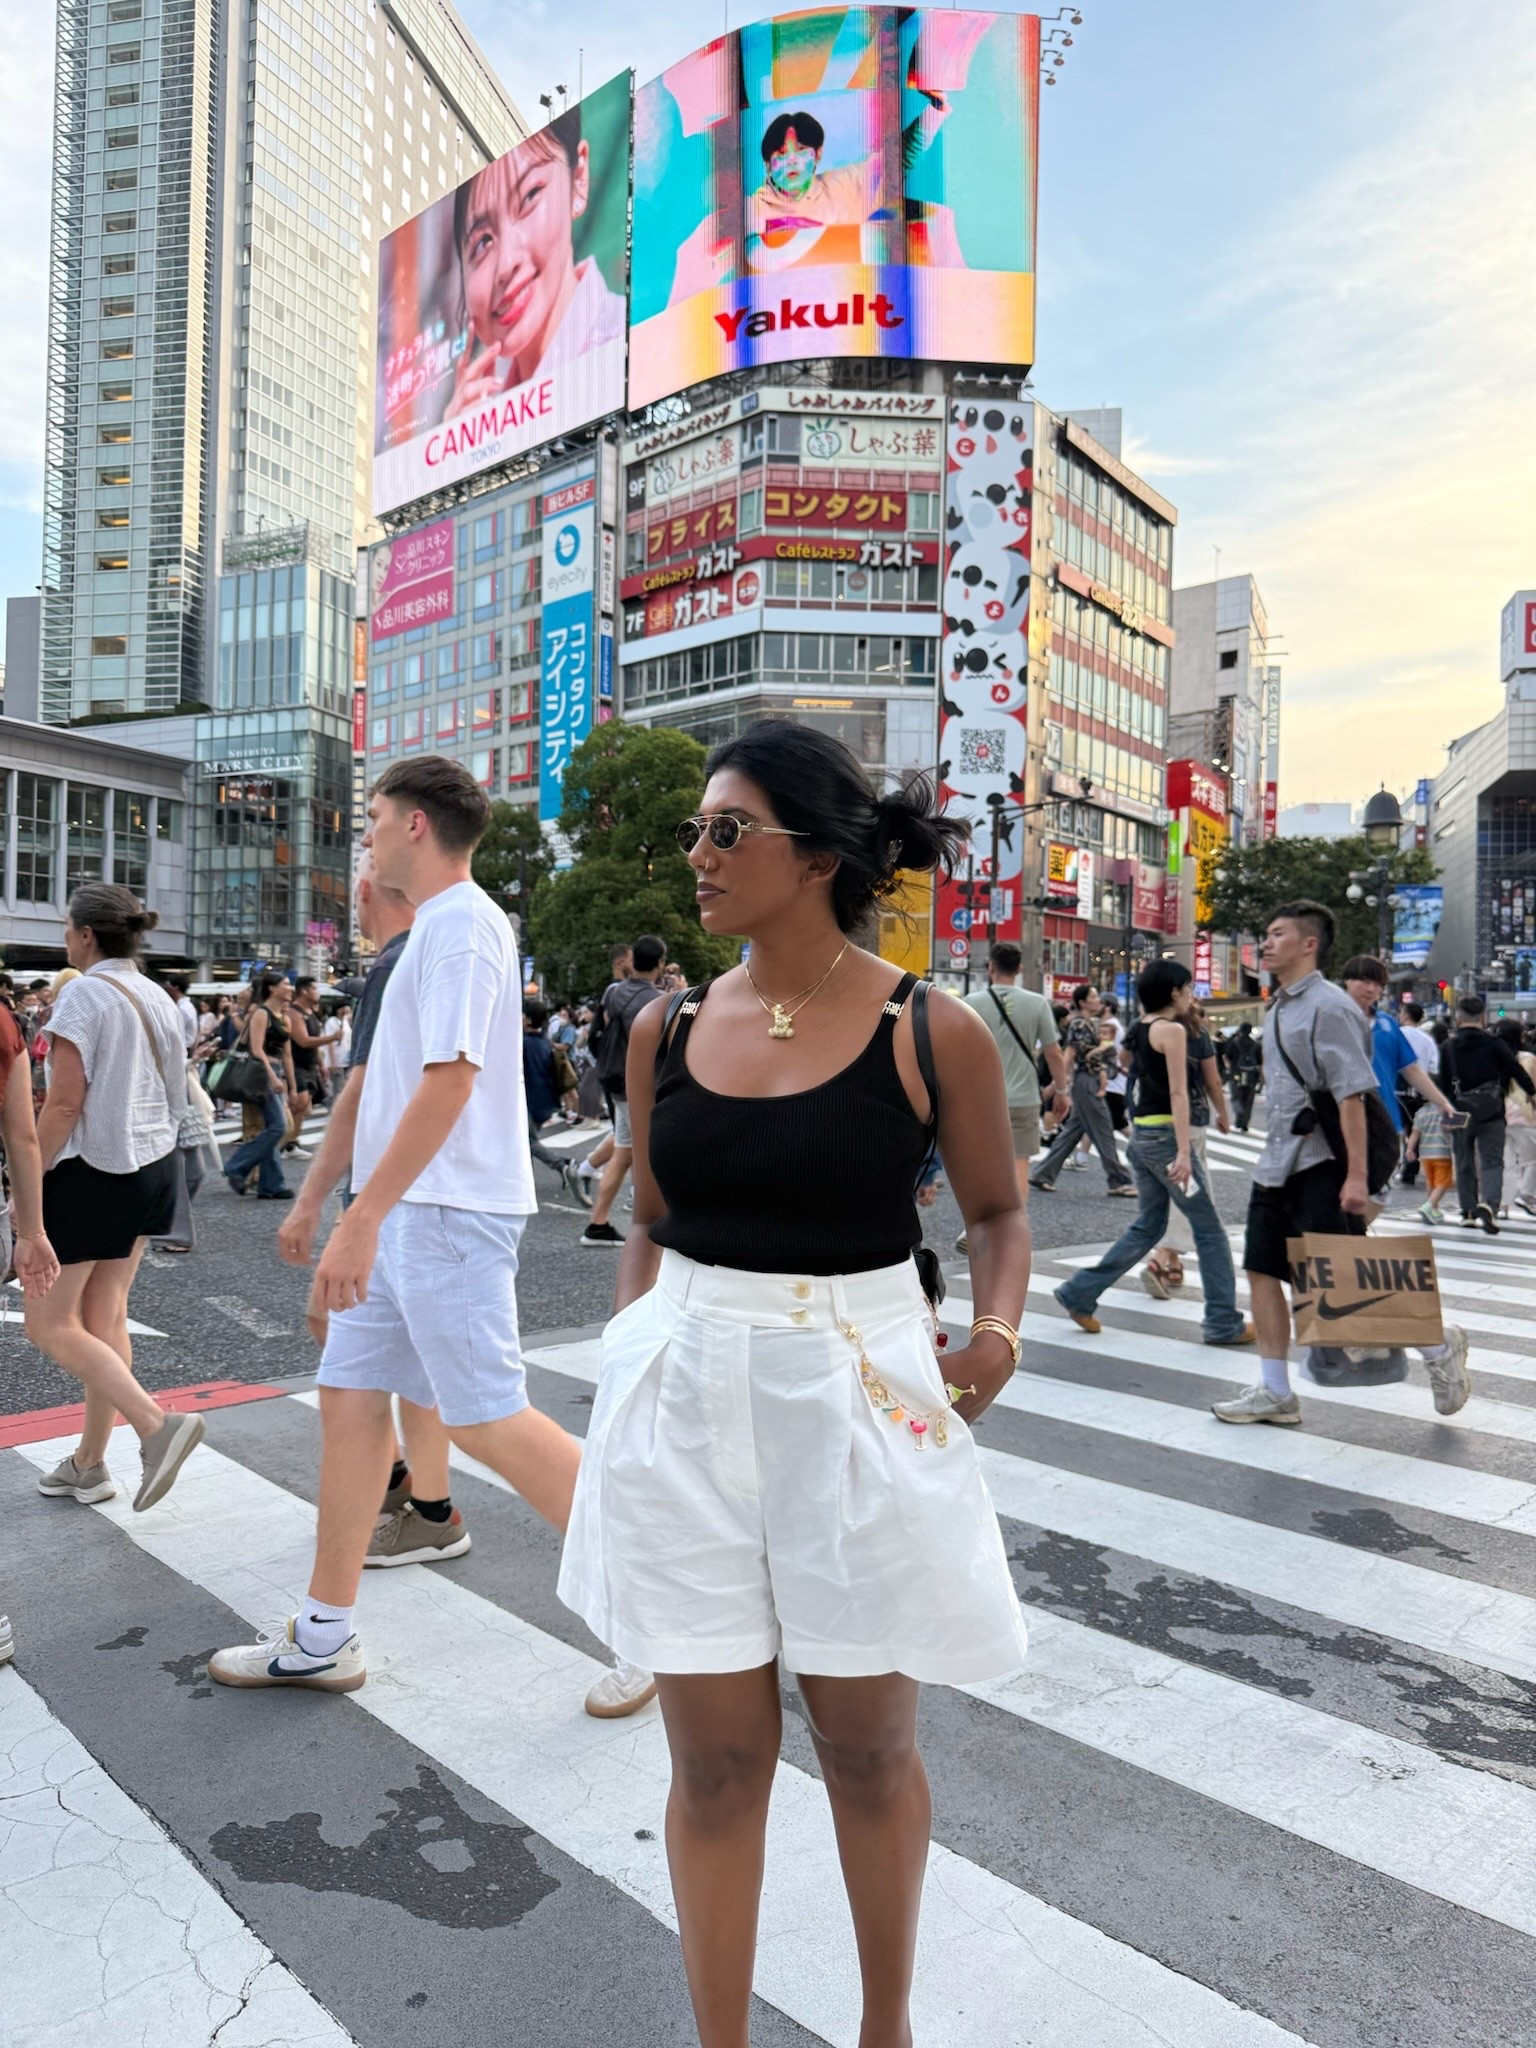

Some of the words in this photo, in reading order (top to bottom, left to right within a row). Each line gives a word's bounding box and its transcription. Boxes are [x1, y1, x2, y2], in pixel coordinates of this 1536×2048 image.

[714, 294, 904, 342] Yakult
[789, 392, 936, 414] しゃぶしゃぶバイキング
[425, 379, 553, 467] CANMAKE
[471, 442, 501, 464] TOKYO
[851, 427, 936, 457] しゃぶ葉
[678, 438, 735, 480] しゃぶ葉
[629, 477, 645, 497] 9F
[766, 492, 902, 522] コンタクト
[697, 546, 742, 580] ガスト
[859, 541, 924, 567] ガスト
[548, 566, 588, 590] eyecity
[626, 611, 645, 633] 7F
[674, 587, 728, 629] ガスト
[570, 622, 586, 748] コンタクト
[546, 627, 568, 784] アイシティ
[204, 760, 253, 773] MARK
[262, 755, 305, 769] CITY
[1354, 1257, 1434, 1292] NIKE
